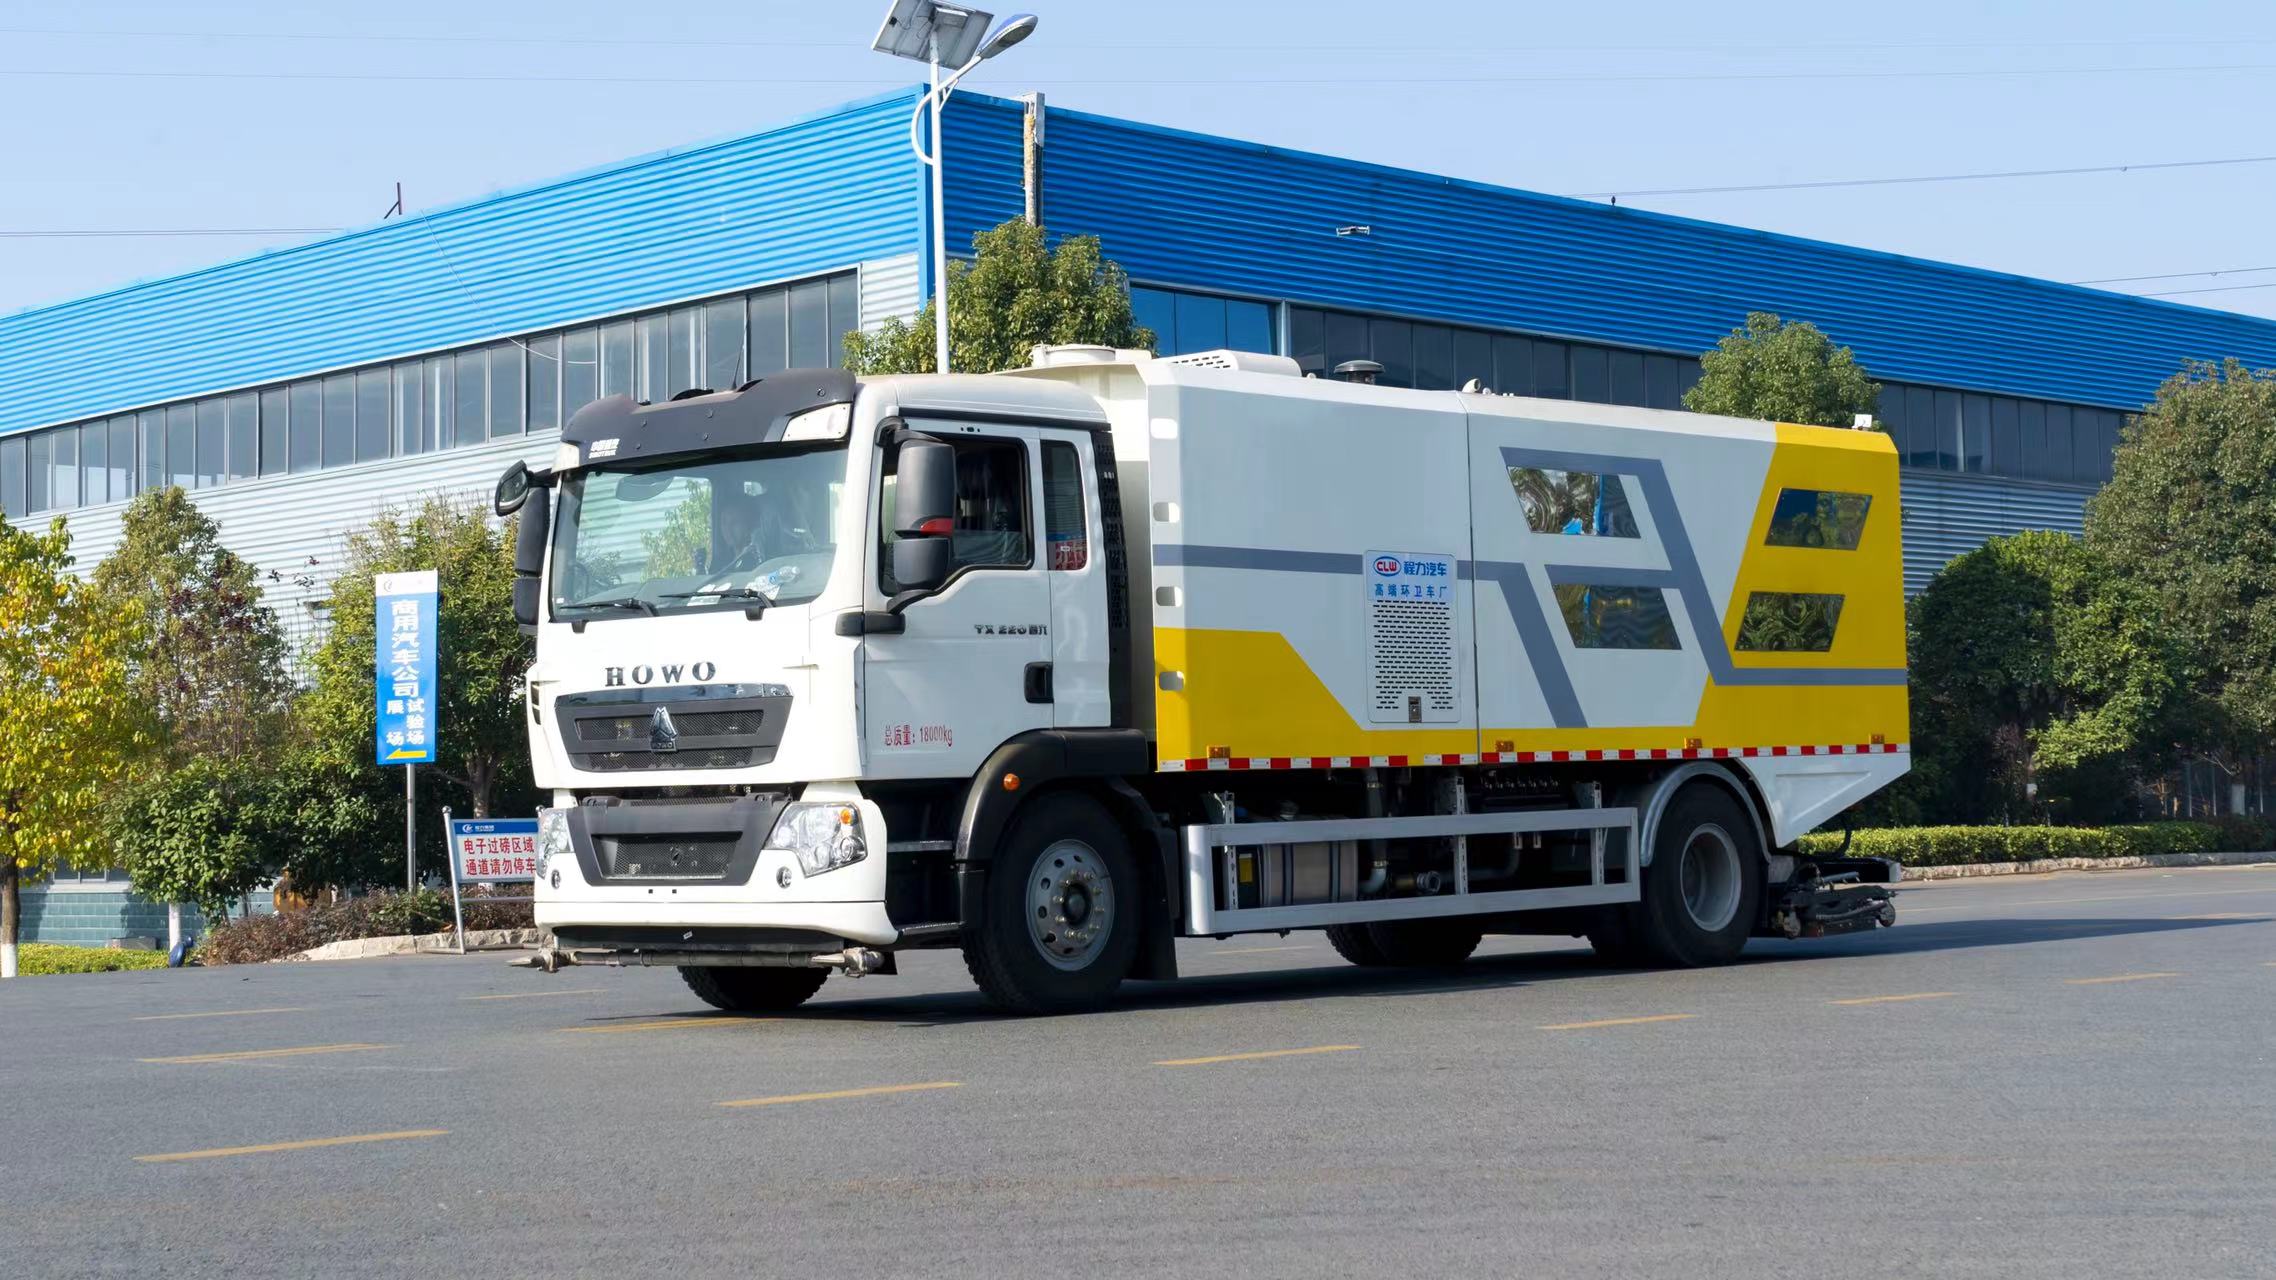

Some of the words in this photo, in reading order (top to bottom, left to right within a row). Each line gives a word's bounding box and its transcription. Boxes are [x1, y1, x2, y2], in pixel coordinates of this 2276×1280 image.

[1376, 561, 1397, 572] CLW
[1403, 561, 1447, 576] 程力汽车
[1375, 583, 1447, 599] 高端环卫车厂
[391, 600, 420, 698] 商用汽车公司
[605, 661, 716, 687] HOWO
[406, 698, 425, 745] 试验场
[464, 837, 534, 854] 电子过磅区域
[466, 857, 537, 876] 通道请勿停车
